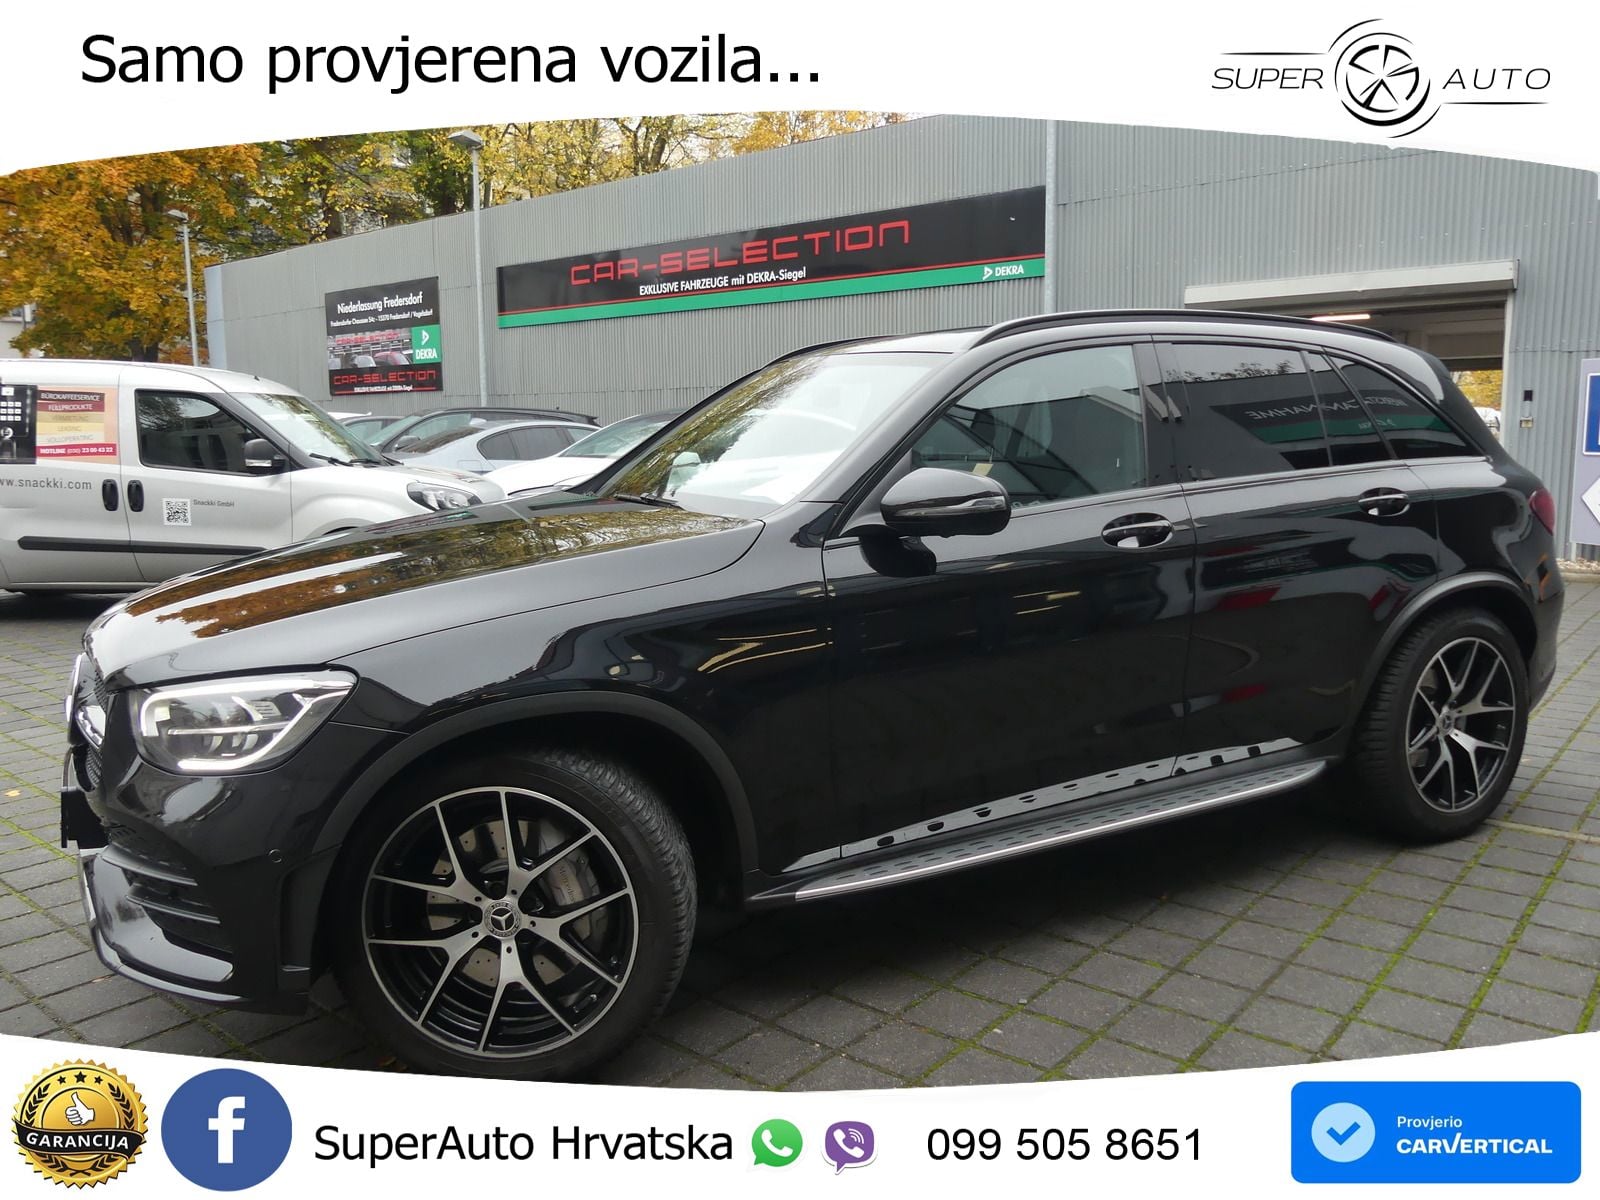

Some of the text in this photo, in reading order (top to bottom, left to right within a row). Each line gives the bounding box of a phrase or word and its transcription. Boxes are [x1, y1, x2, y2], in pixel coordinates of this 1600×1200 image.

[571, 220, 909, 286] CAR-SELECTION
[995, 263, 1025, 277] DEKRA
[639, 266, 806, 296] EXKLUSIVE FAHRZEUGE mit DEKRA-Siegel
[337, 291, 423, 314] Niederlassung Fredersdorf
[415, 348, 438, 360] DEKRA
[334, 370, 436, 384] CAR-SELECTION
